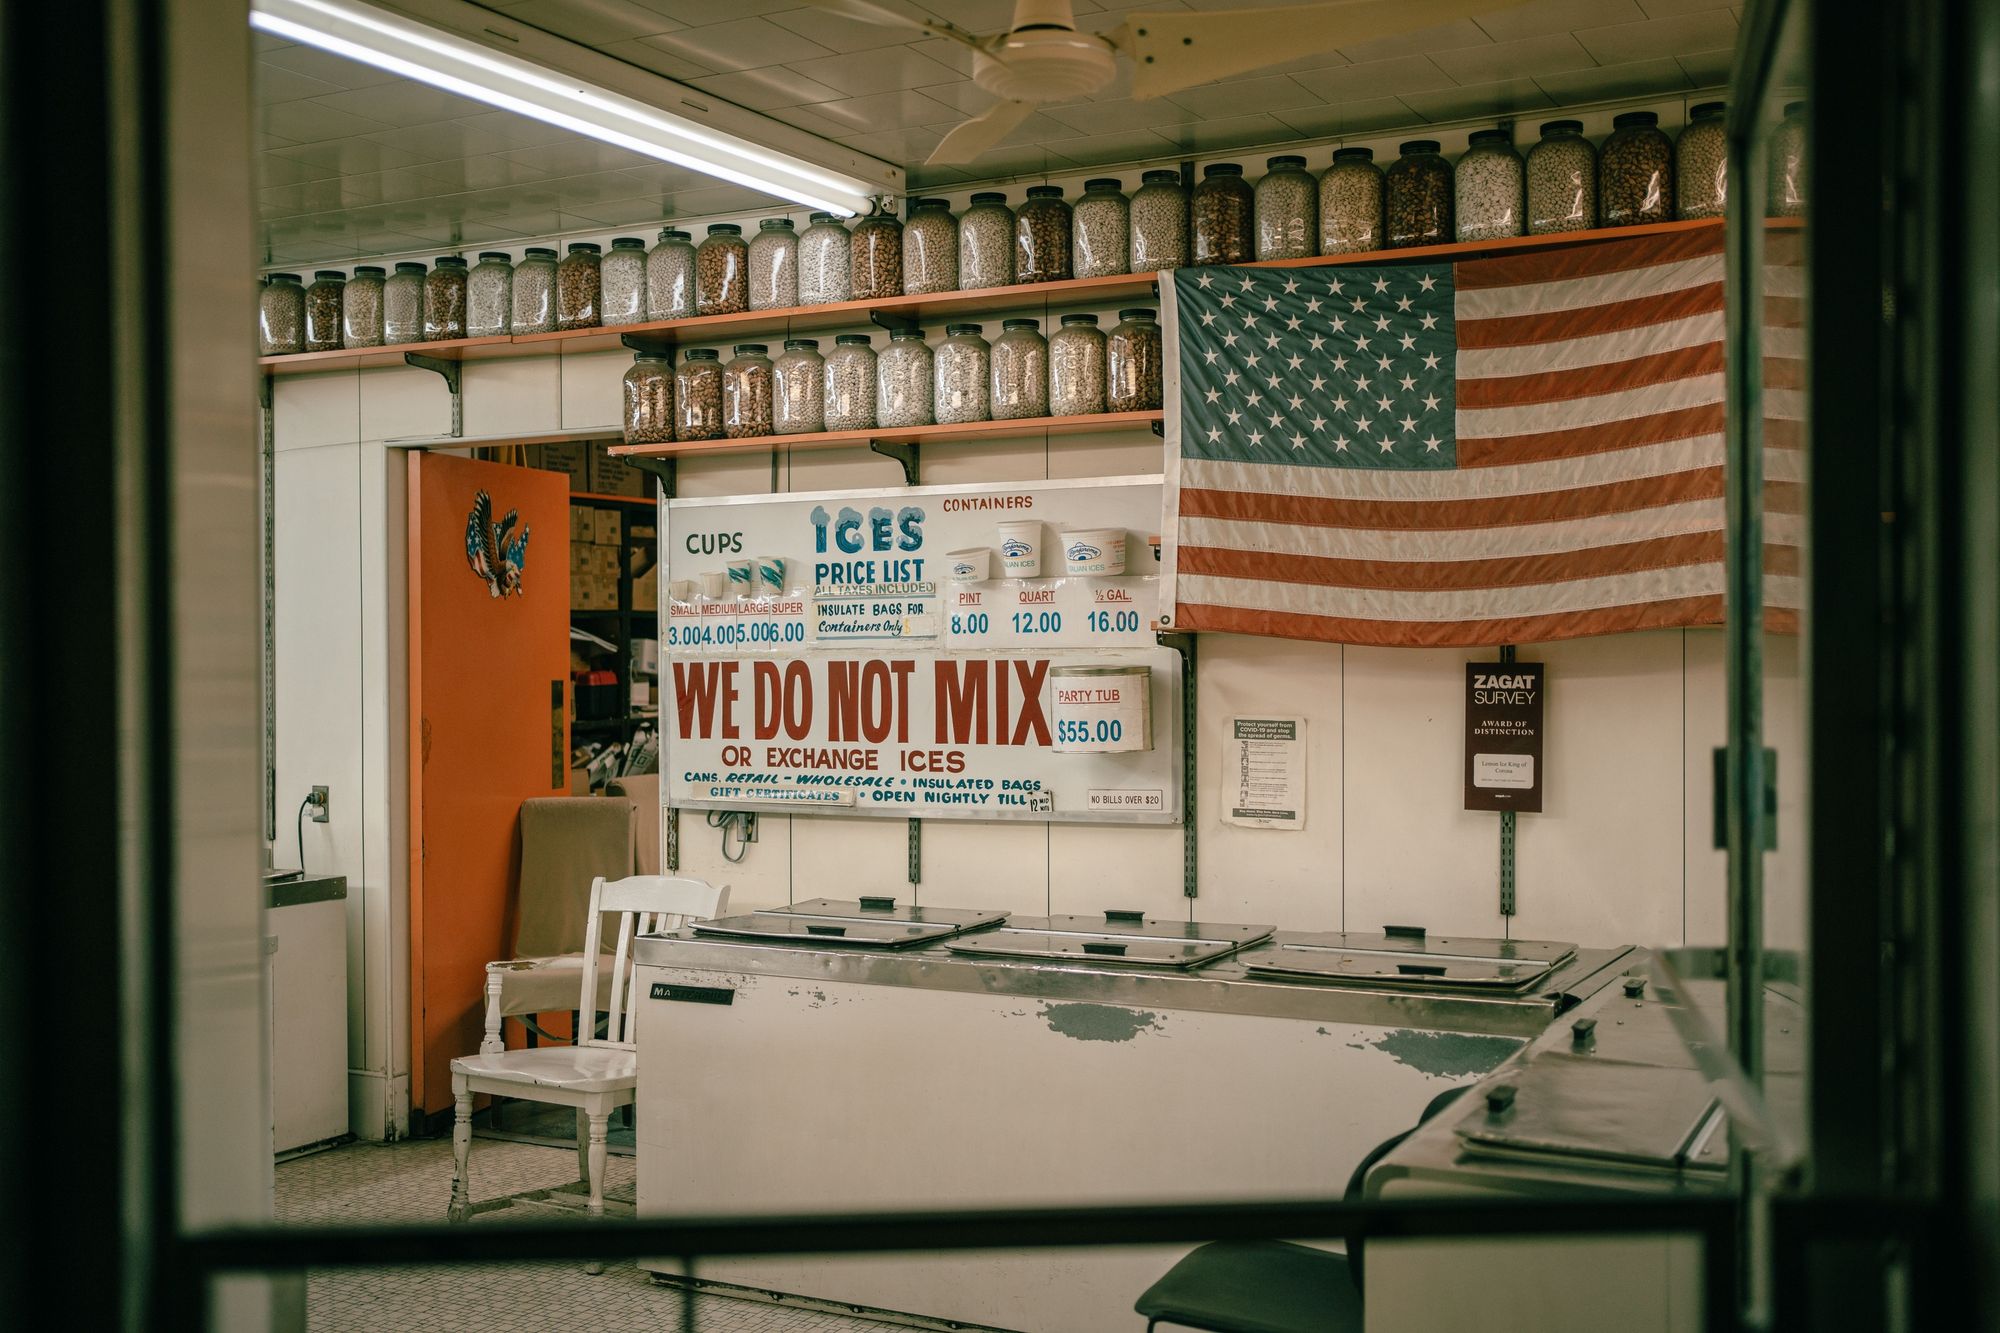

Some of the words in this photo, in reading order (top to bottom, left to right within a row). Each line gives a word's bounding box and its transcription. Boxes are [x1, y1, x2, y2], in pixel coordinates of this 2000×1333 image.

[943, 495, 1033, 512] CONTAINERS
[810, 505, 926, 554] ICES
[686, 532, 744, 555] CUPS
[816, 560, 876, 585] PRICE
[884, 558, 924, 582] LIST
[814, 584, 834, 596] ALL
[838, 584, 873, 595] TAXES
[875, 582, 935, 594] INCLUDED
[1019, 590, 1056, 602] QUART
[1107, 588, 1132, 600] GAL.
[959, 592, 982, 604] PINT
[670, 604, 699, 615] SMALL
[702, 603, 736, 614] MEDIUM
[738, 602, 768, 614] LARGE
[771, 602, 803, 614] SUPER
[817, 602, 865, 616] INSULATE
[873, 602, 902, 616] BAGS
[908, 602, 924, 615] FOR
[818, 620, 881, 633] Containers
[883, 619, 904, 636] Only
[951, 613, 989, 634] 8.00
[1012, 612, 1062, 634] 12.00
[1088, 610, 1139, 632] 16.00
[668, 626, 700, 646] 3.00
[702, 624, 736, 645] 4.00
[736, 622, 770, 644] 5.00
[770, 622, 804, 642] 6.00
[1474, 674, 1535, 689] ZAGAT
[673, 661, 740, 740] WE
[754, 659, 813, 741] DO
[828, 659, 916, 744] NOT
[934, 659, 1053, 747] MIX
[1059, 690, 1092, 702] PARTY
[1096, 690, 1120, 701] TUB
[1474, 690, 1536, 705] SURVEY
[1058, 719, 1122, 744] $55.00
[1474, 728, 1534, 736] DISTINCTION
[1481, 720, 1513, 728] AWARD
[1515, 720, 1528, 728] OF
[721, 745, 752, 768] OR
[766, 748, 878, 771] EXCHANGE
[900, 750, 966, 774] ICES
[684, 772, 721, 783] CANS.
[725, 772, 780, 784] RETAIL
[796, 774, 896, 788] WHOLESALE
[912, 778, 998, 791] INSULATED
[1002, 779, 1042, 792] BAGS
[710, 787, 742, 799] GIFT
[746, 788, 841, 802] CERTIFICATES
[872, 790, 915, 802] OPEN
[924, 792, 990, 805] NIGHTLY
[997, 793, 1026, 806] TILL
[1091, 796, 1100, 804] NO
[1102, 796, 1122, 804] BILLS
[1125, 796, 1142, 804] OVER
[1146, 796, 1160, 804] $20
